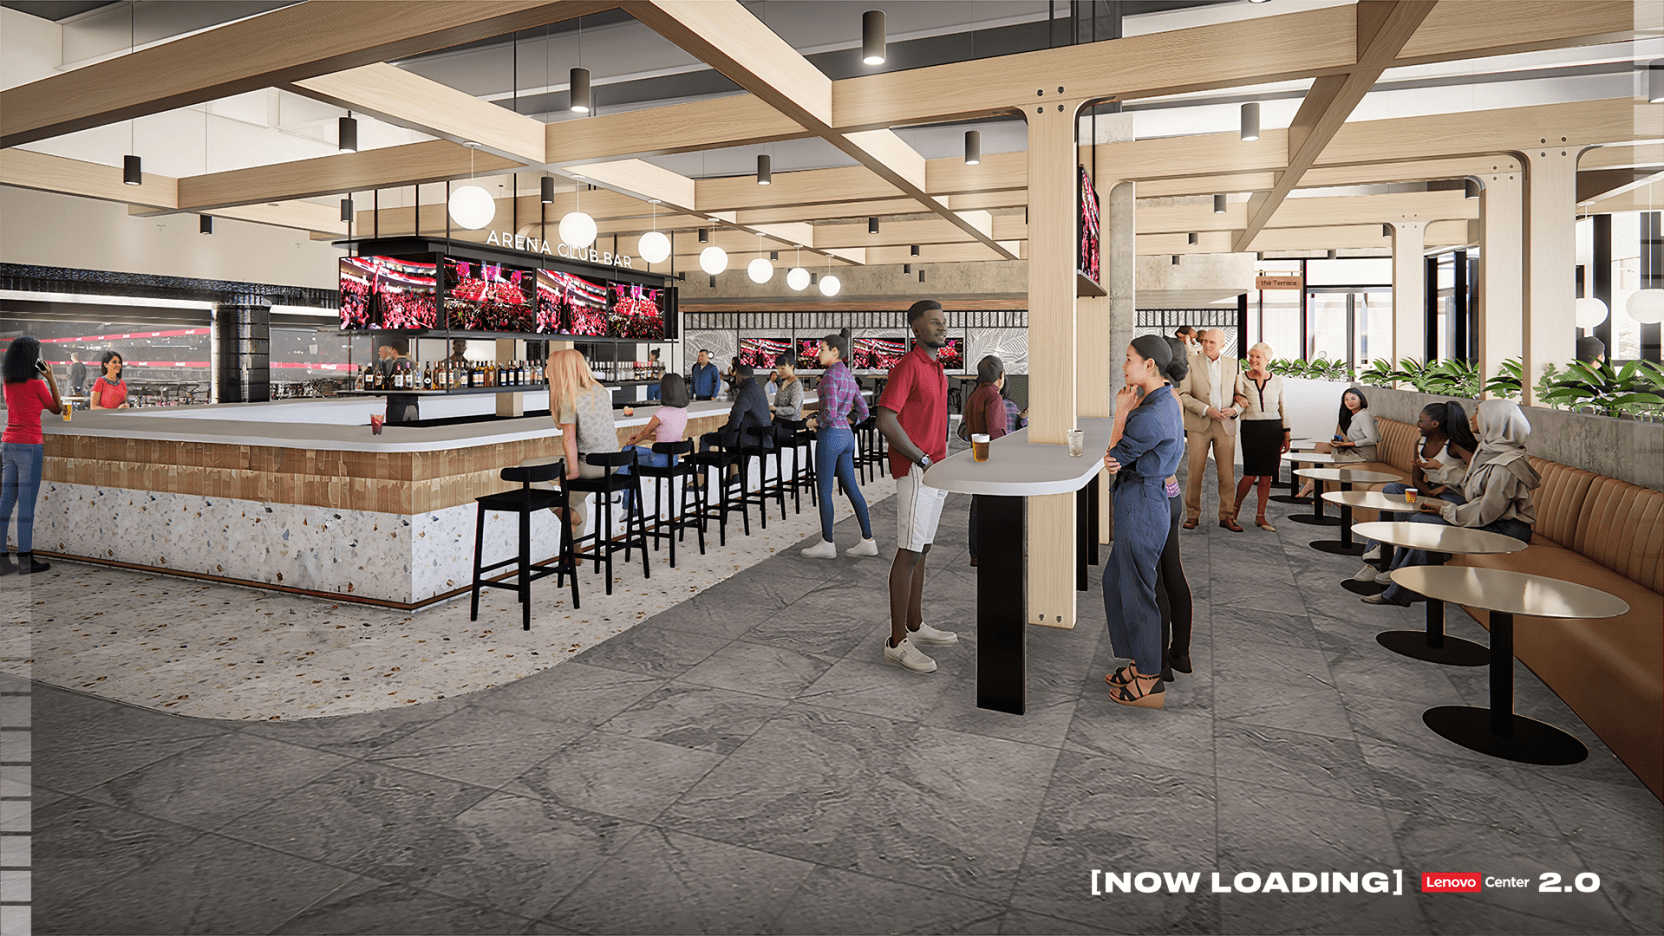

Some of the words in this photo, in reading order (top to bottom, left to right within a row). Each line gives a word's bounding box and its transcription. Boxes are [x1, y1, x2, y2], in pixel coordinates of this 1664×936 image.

[486, 230, 552, 255] ARENA
[557, 243, 599, 263] CLUB
[603, 251, 632, 269] BAR
